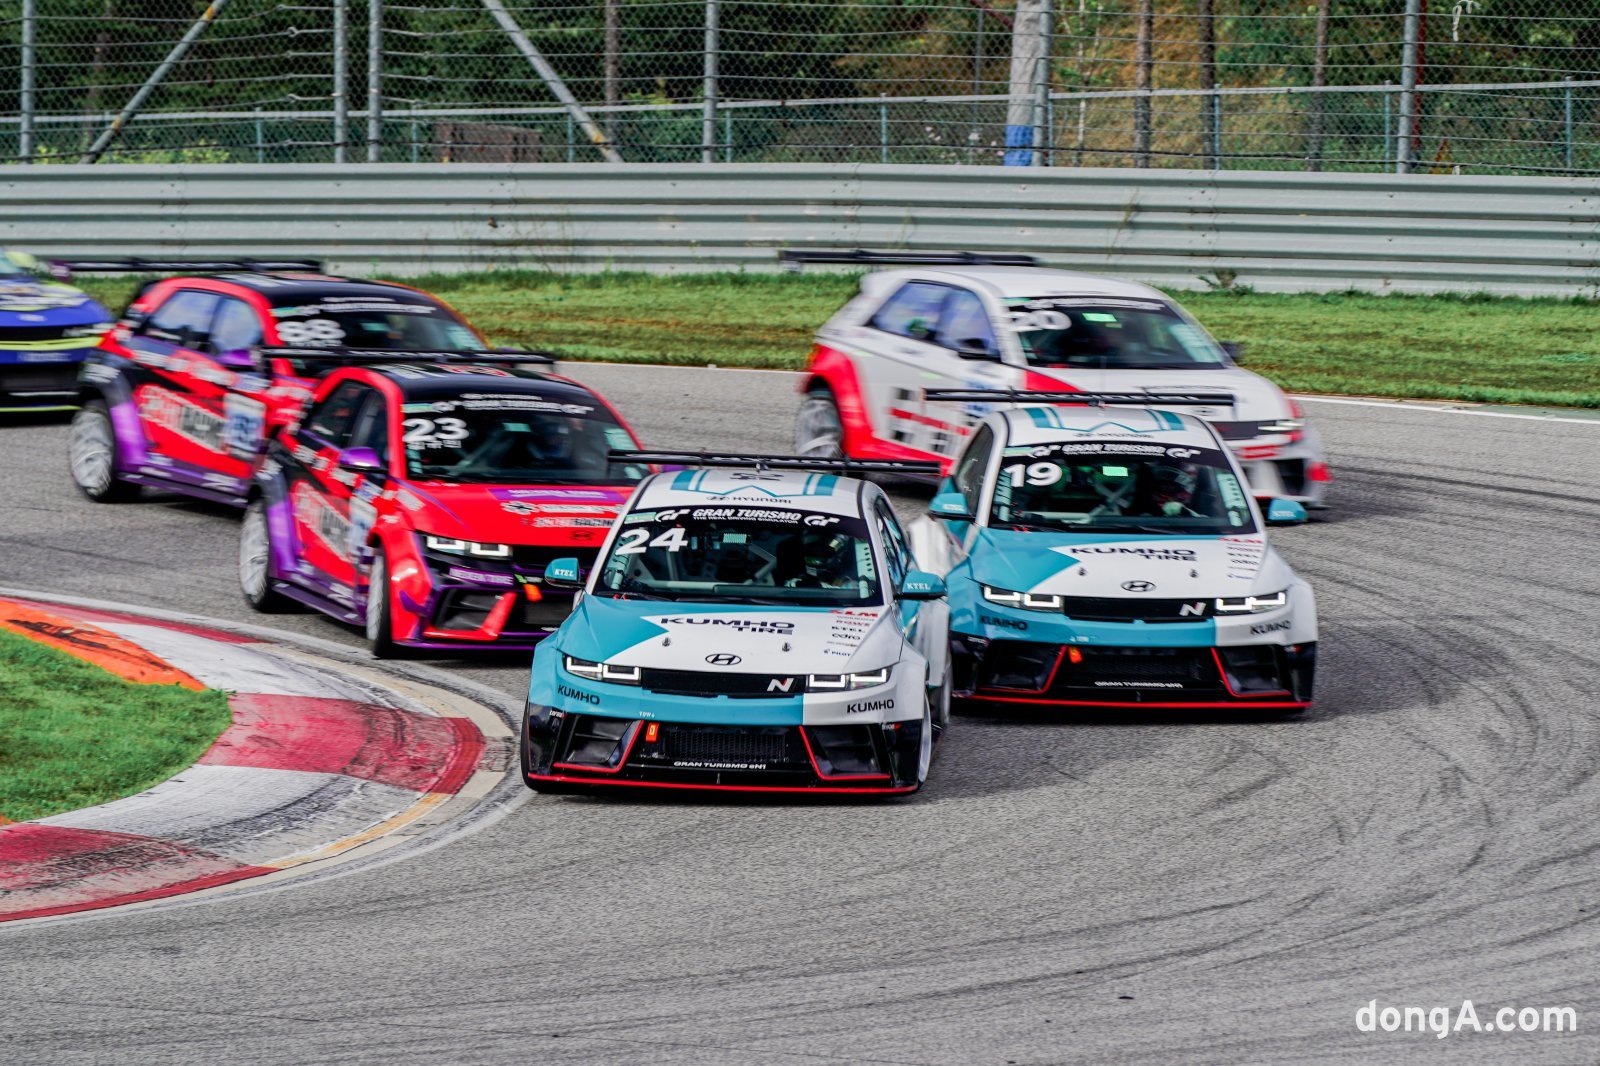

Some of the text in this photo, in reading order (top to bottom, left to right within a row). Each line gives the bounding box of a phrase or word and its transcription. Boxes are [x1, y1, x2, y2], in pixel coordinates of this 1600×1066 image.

[402, 417, 470, 442] 23
[1003, 461, 1063, 488] 19
[733, 496, 792, 504] HYUNDAI
[692, 508, 735, 517] GRAN
[736, 509, 802, 520] TURISMO
[615, 527, 689, 556] 24
[1070, 547, 1197, 556] KUMHO
[1139, 554, 1197, 562] TIRE
[554, 568, 574, 577] KTEL
[906, 582, 931, 591] KTEL
[660, 618, 795, 629] KUMHO
[979, 615, 1028, 631] KUMHO
[1250, 620, 1292, 635] KUMHO
[731, 626, 793, 635] TIRE
[557, 684, 600, 705] KUMHO
[846, 699, 895, 714] KUMHO
